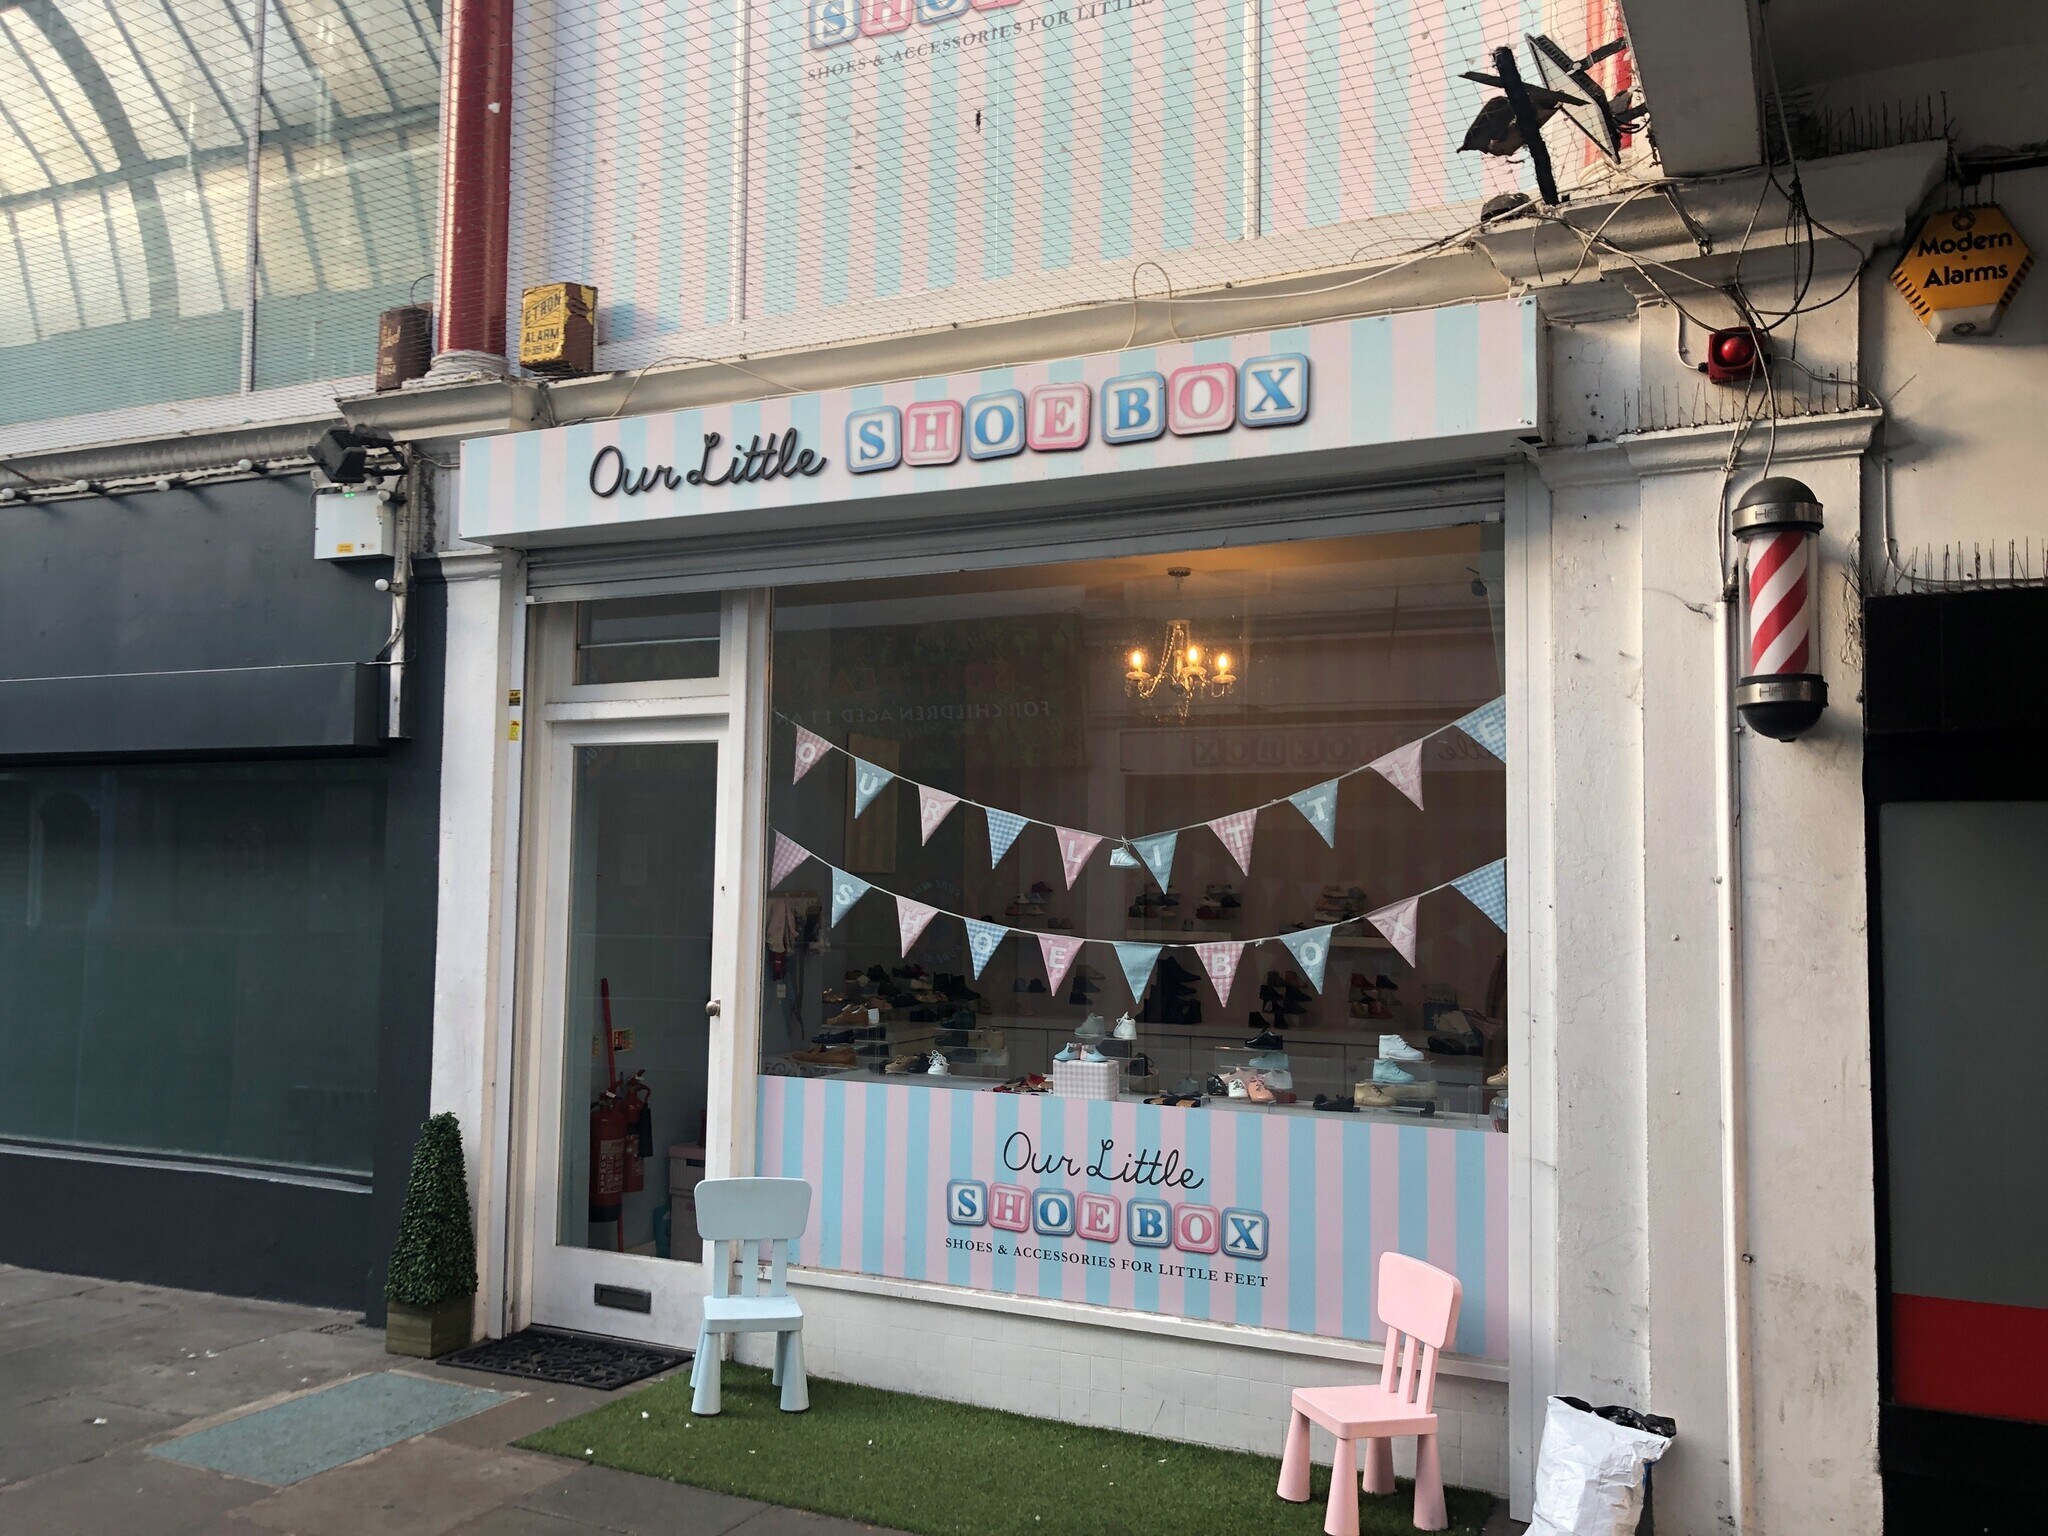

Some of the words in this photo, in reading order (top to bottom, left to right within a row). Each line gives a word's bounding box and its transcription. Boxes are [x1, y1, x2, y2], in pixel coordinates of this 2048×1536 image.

[807, 56, 868, 82] SHOES
[872, 54, 885, 68] &
[892, 22, 1023, 64] ACCESSORIES
[1029, 11, 1070, 33] FOR
[1917, 231, 2014, 257] Modern
[1923, 263, 2009, 289] Alarms
[524, 327, 561, 344] ALARM
[588, 445, 683, 498] Our
[685, 426, 830, 486] Little
[1002, 1130, 1082, 1177] Our
[1086, 1138, 1206, 1190] Little
[944, 1237, 994, 1254] SHOES
[997, 1244, 1009, 1256] &
[1013, 1246, 1117, 1270] ACCESSORIES
[1121, 1259, 1153, 1274] FOR
[1158, 1263, 1219, 1283] LITTLE
[1224, 1272, 1269, 1289] FEET
